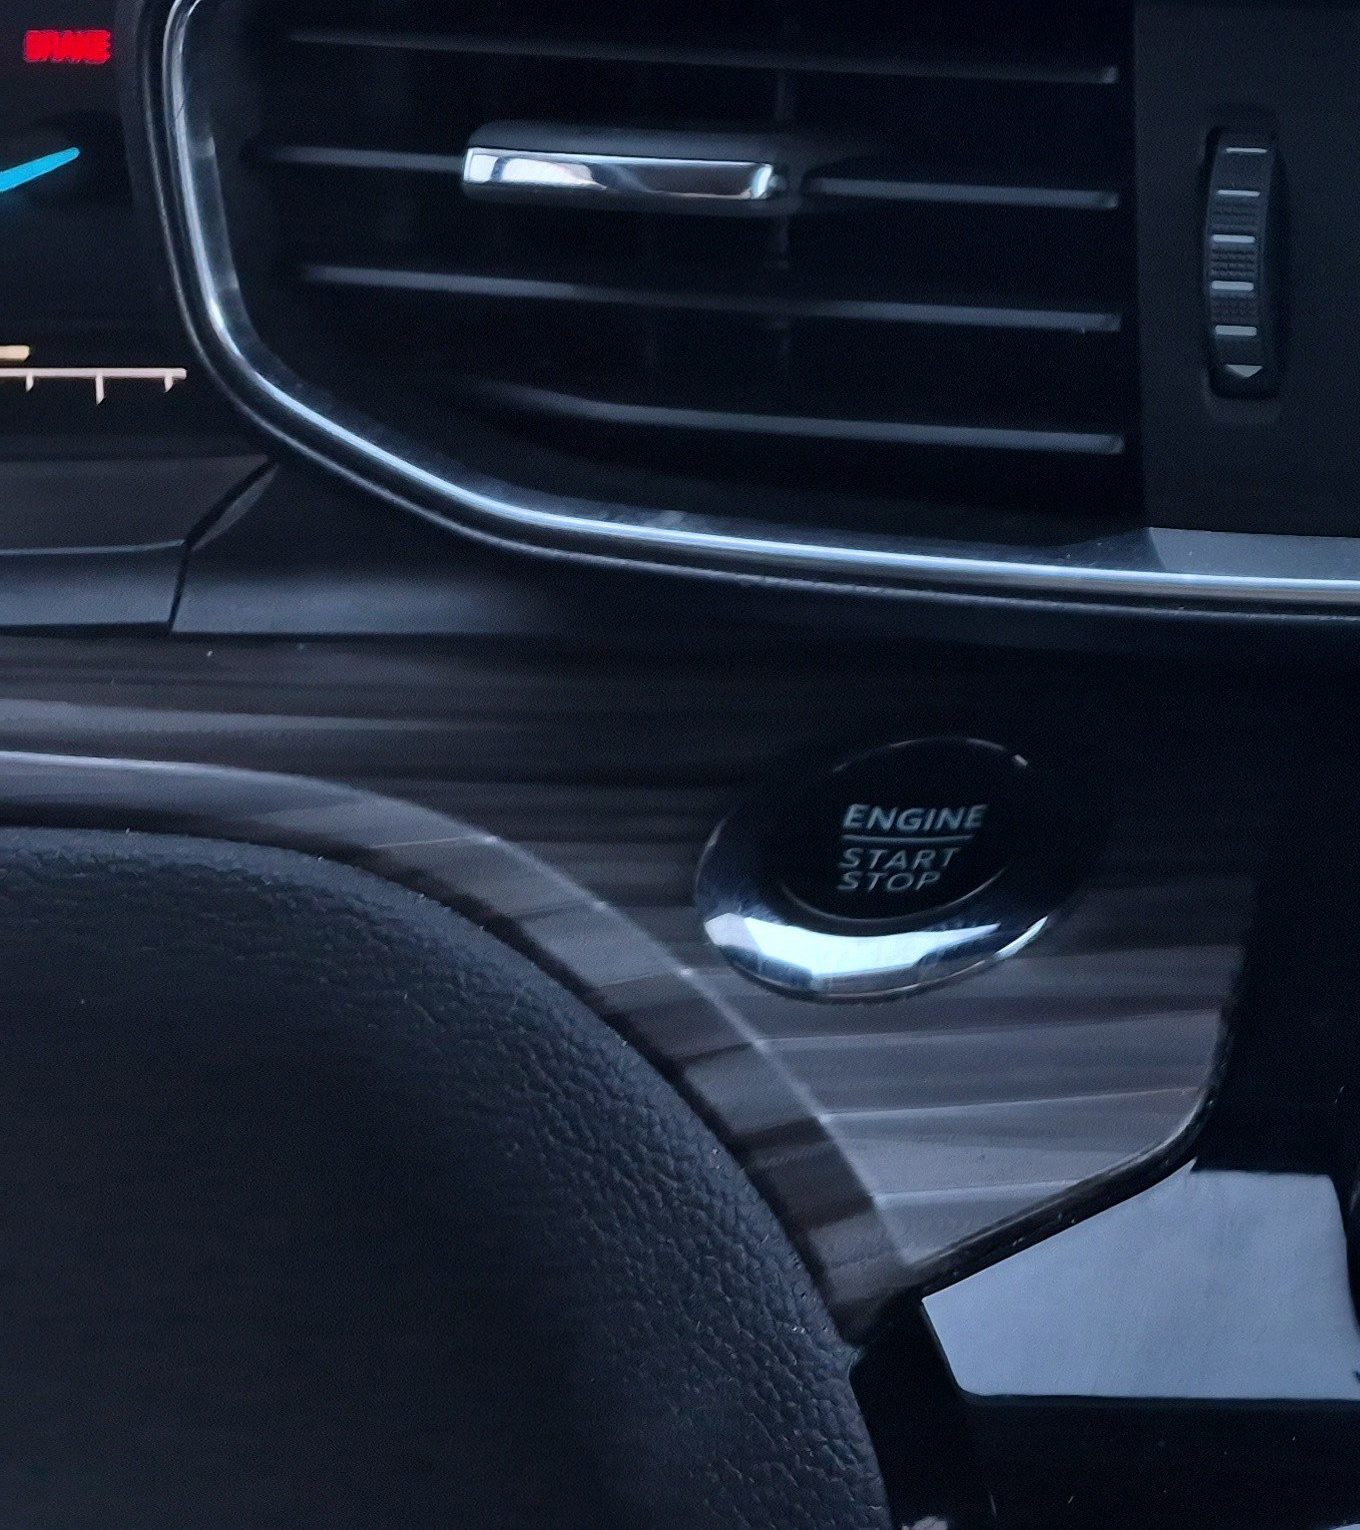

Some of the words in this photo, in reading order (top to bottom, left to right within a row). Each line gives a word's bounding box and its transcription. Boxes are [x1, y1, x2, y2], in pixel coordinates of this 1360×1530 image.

[842, 803, 990, 833] ENGINE
[838, 846, 966, 872] START
[836, 872, 942, 893] STOP
